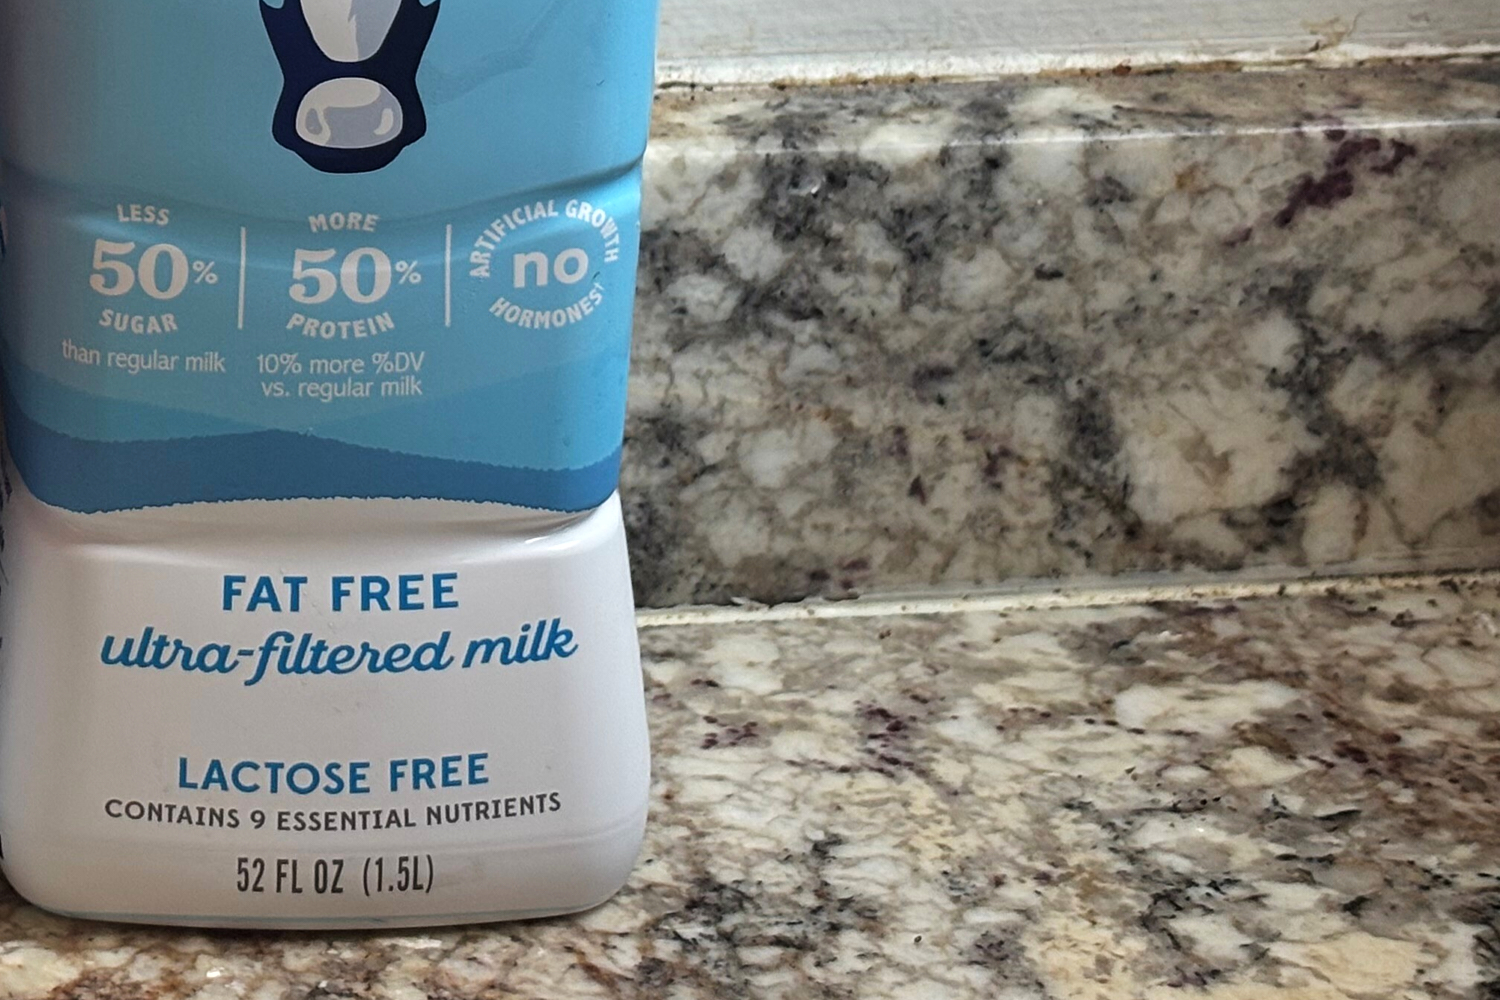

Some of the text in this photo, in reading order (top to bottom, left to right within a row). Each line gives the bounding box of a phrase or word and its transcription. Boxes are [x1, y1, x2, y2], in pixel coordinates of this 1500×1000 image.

[117, 204, 169, 226] LESS
[309, 212, 379, 232] MORE
[470, 199, 619, 278] ARTIFICIAL GROWTH
[89, 238, 218, 300] 50%
[288, 247, 422, 304] 50%
[514, 248, 589, 288] no
[99, 309, 177, 335] SUGAR
[286, 311, 395, 340] PROTEIN
[62, 339, 227, 375] than regular milk
[256, 352, 425, 375] 10% more %DV
[262, 374, 423, 403] vs. regular milk
[221, 572, 459, 612] FAT FREE
[100, 617, 579, 686] ultra-filtered milk
[178, 752, 490, 795] LACTOSE FREE
[104, 792, 562, 832] CONTAINS 9 ESSENTIAL NUTRIENTS
[236, 854, 434, 896] 52 FL OZ (1.5L)
